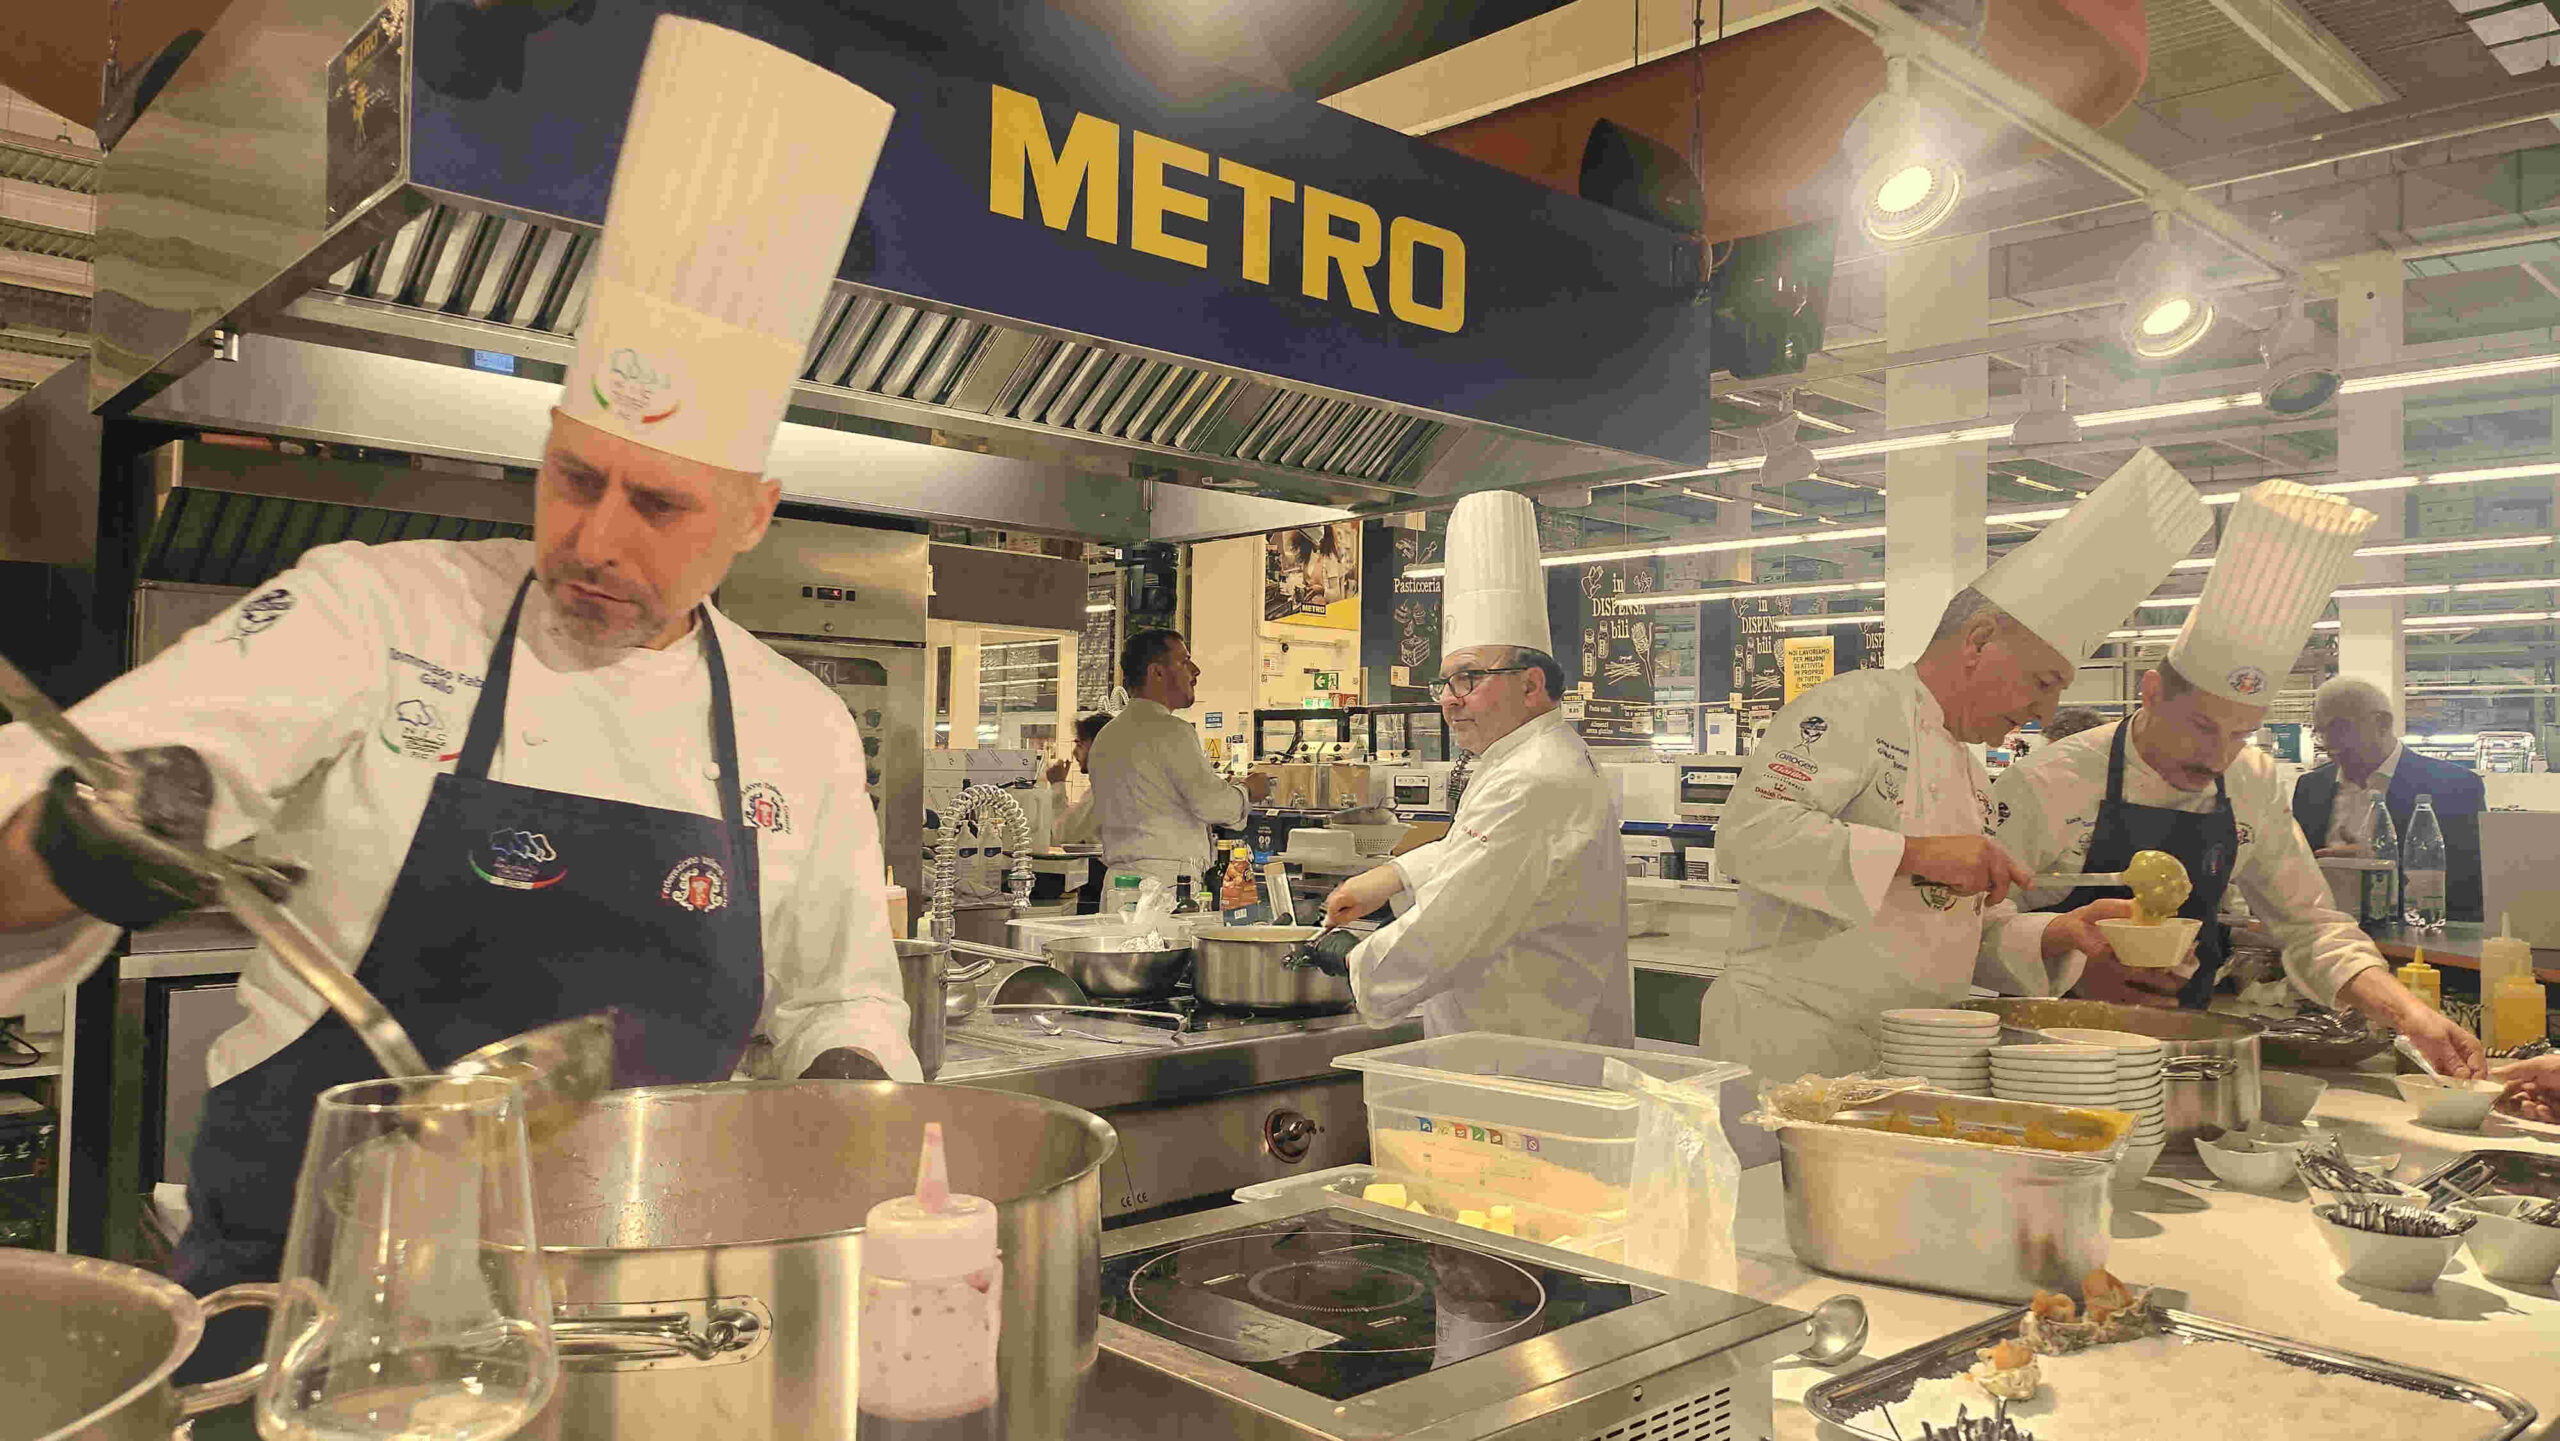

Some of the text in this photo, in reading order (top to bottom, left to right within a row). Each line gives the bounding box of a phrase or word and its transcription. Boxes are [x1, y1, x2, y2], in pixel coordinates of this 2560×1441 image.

[989, 83, 1466, 334] METRO
[1393, 577, 1441, 593] Pasticceria
[1613, 572, 1625, 593] in
[1302, 604, 1325, 614] METRO
[1610, 618, 1630, 639] bili
[1865, 632, 1884, 649] DISP
[458, 672, 486, 690] Fab
